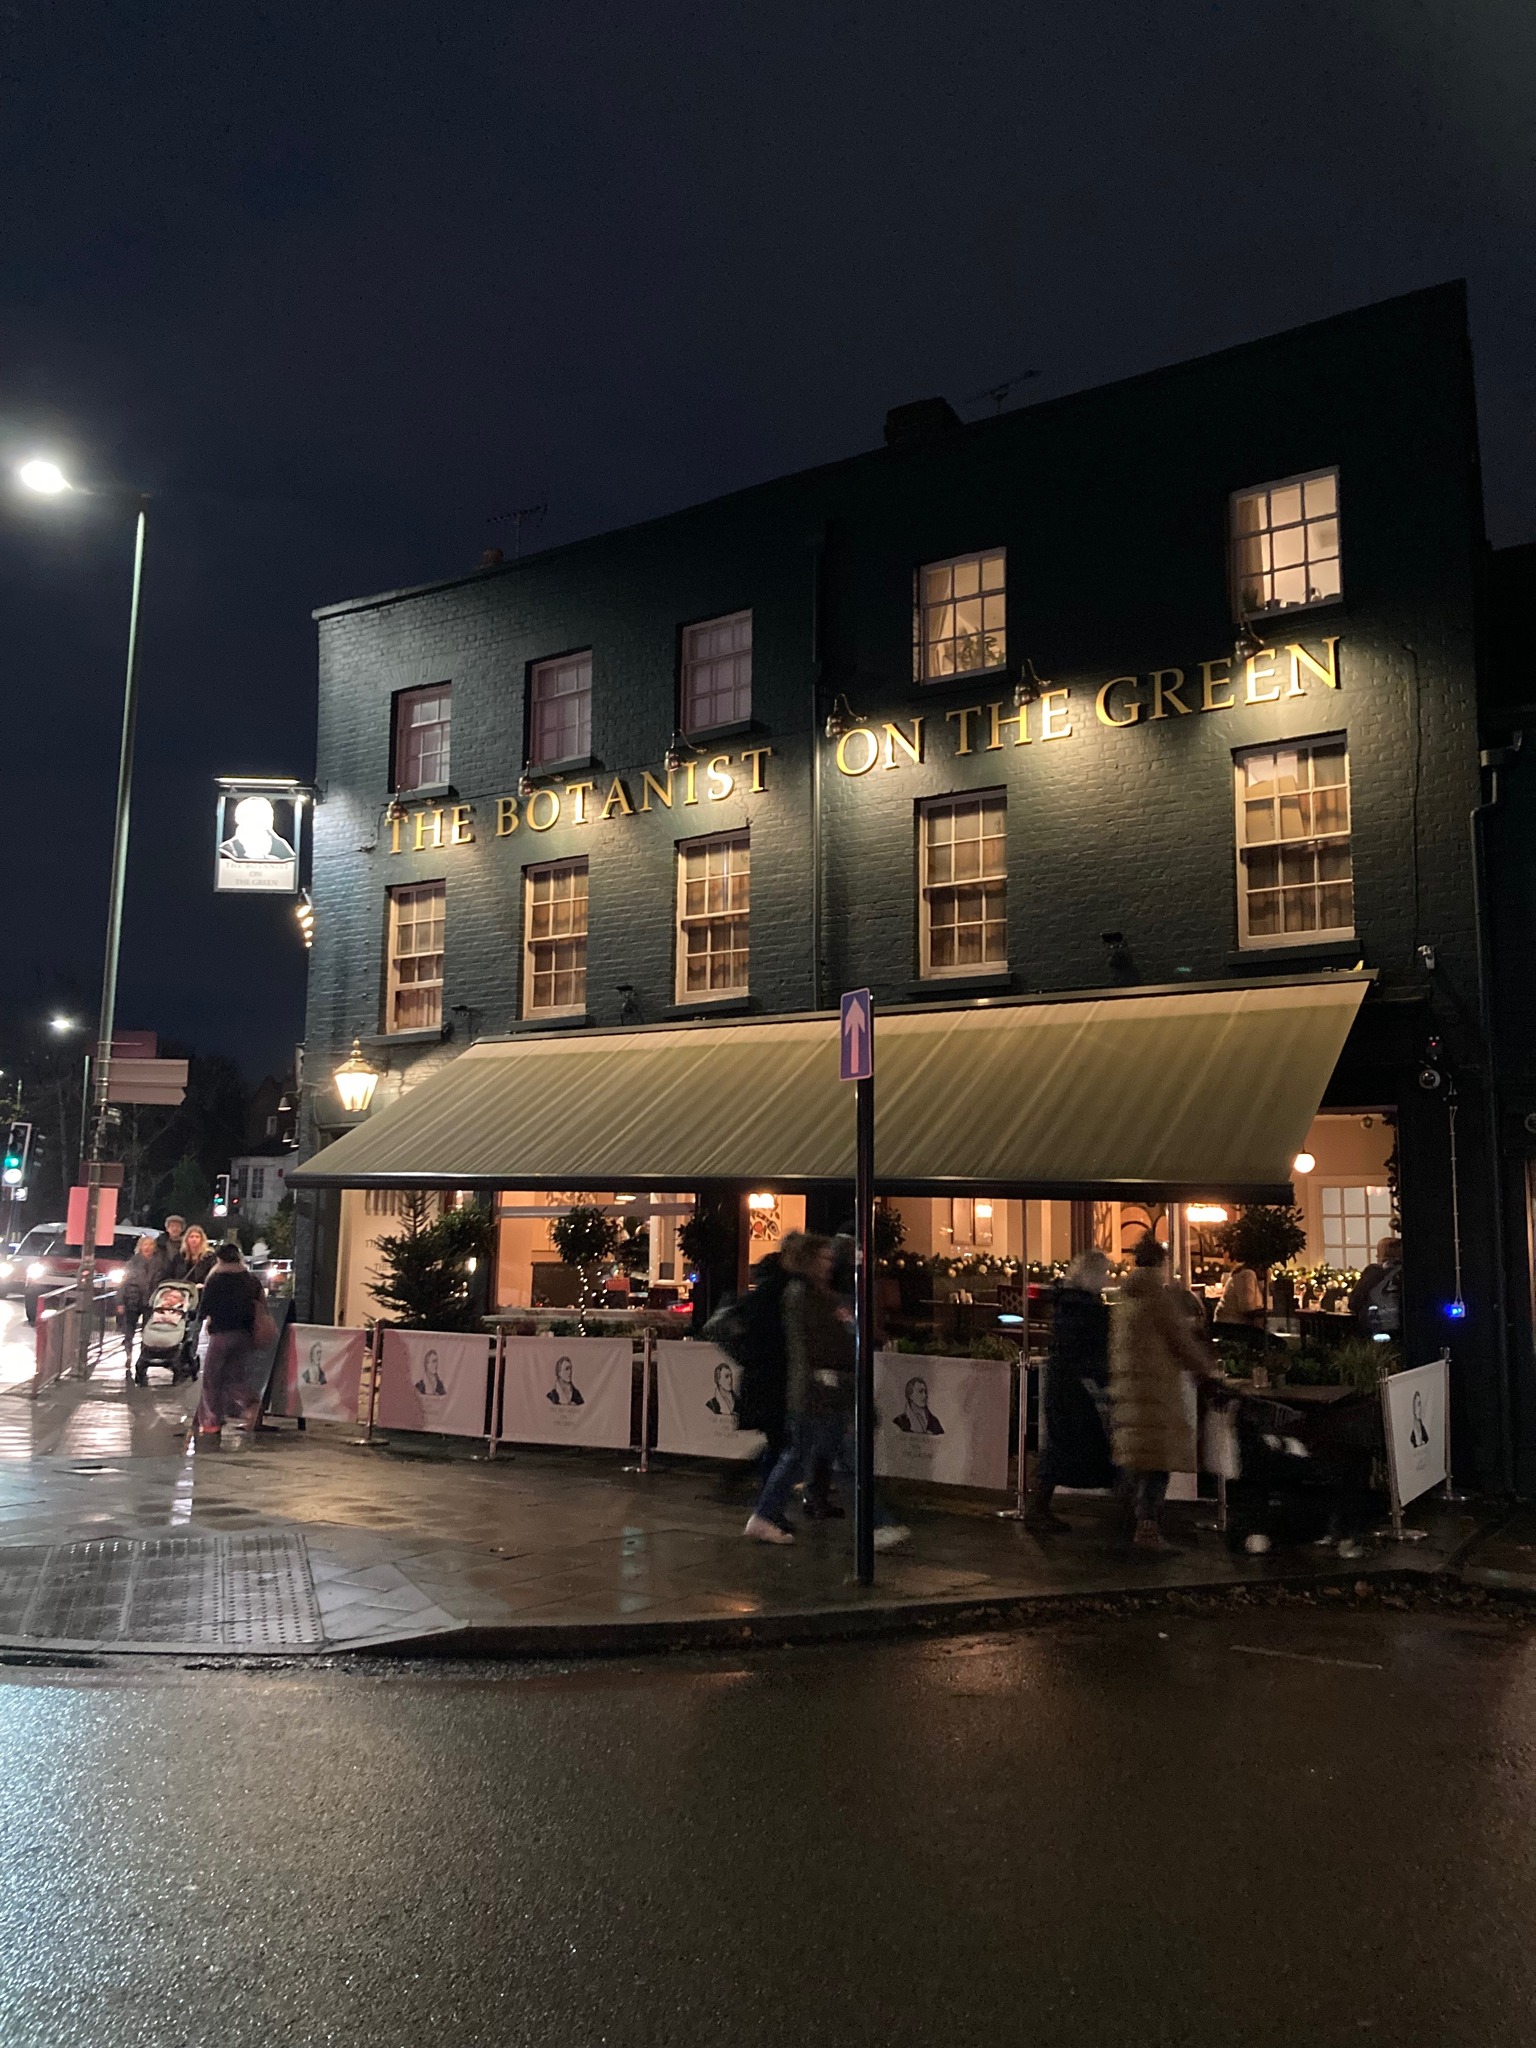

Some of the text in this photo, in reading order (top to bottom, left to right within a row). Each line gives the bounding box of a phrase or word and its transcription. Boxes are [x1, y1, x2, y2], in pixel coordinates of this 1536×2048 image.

[384, 636, 1341, 854] THE BOTANIST ON THE GREEN
[249, 870, 263, 878] ON
